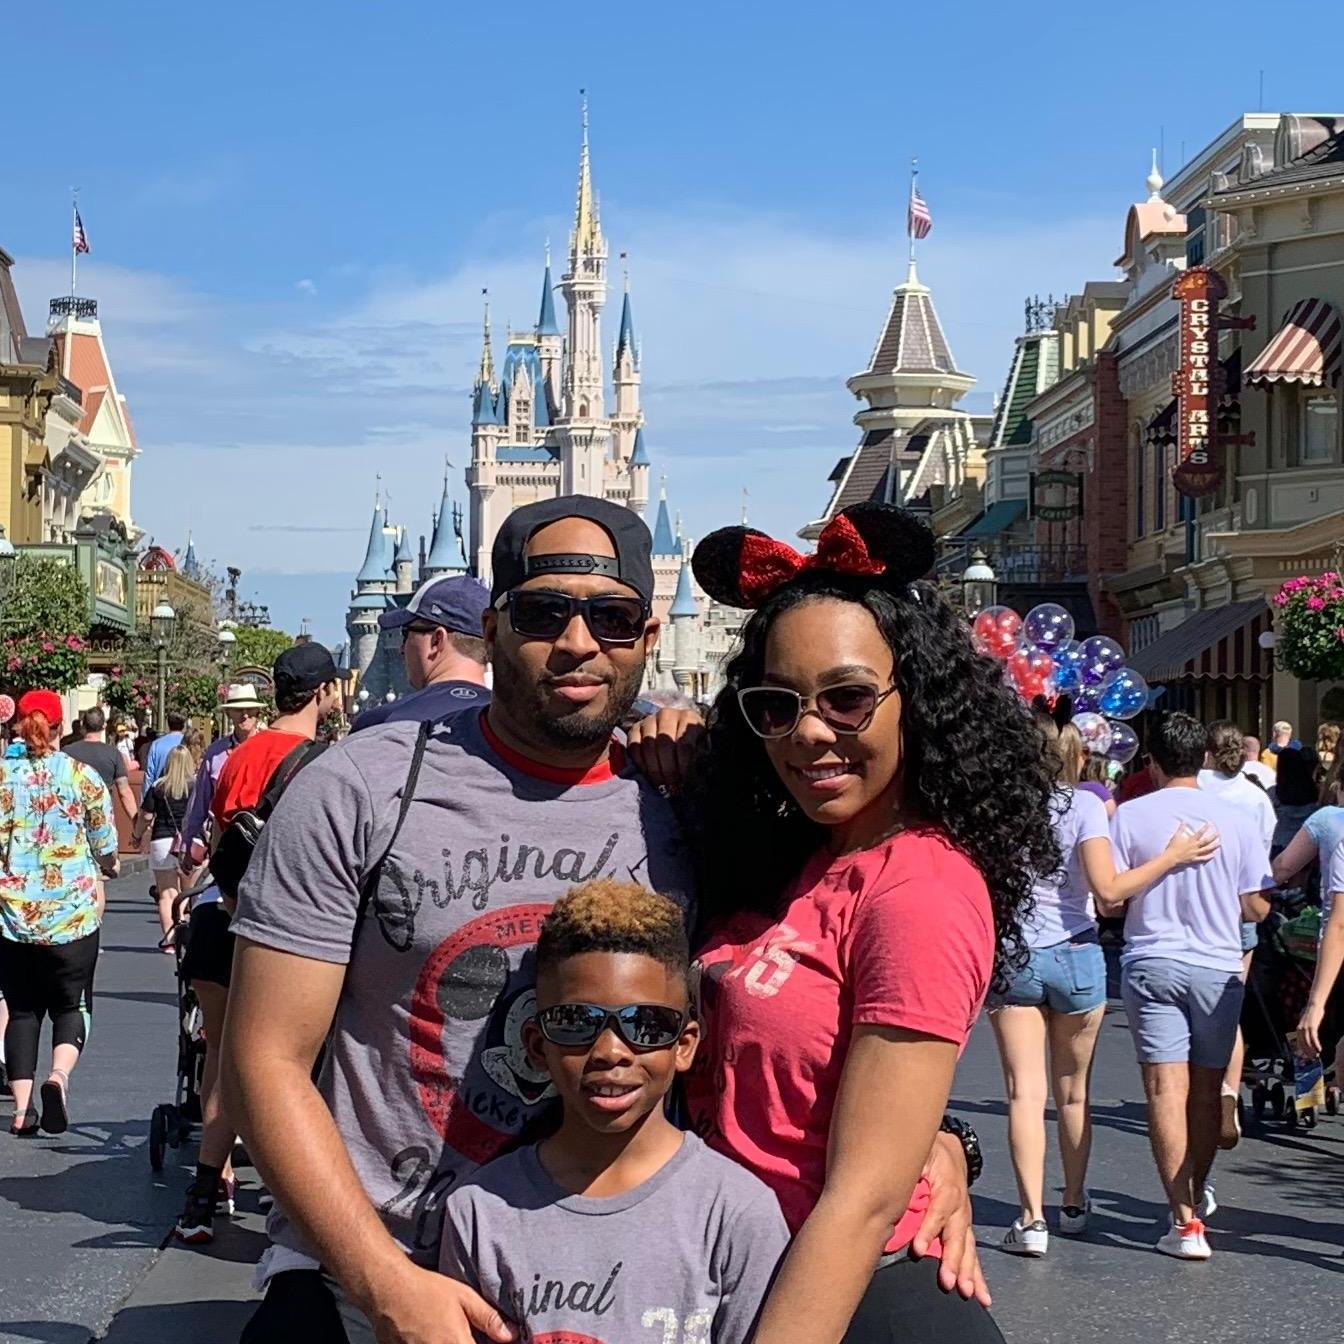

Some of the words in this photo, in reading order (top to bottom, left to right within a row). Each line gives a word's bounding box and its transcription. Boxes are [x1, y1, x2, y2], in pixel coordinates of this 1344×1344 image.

[1188, 299, 1210, 396] CRYSTAL
[1188, 409, 1210, 465] ARTS
[374, 833, 620, 952] Original
